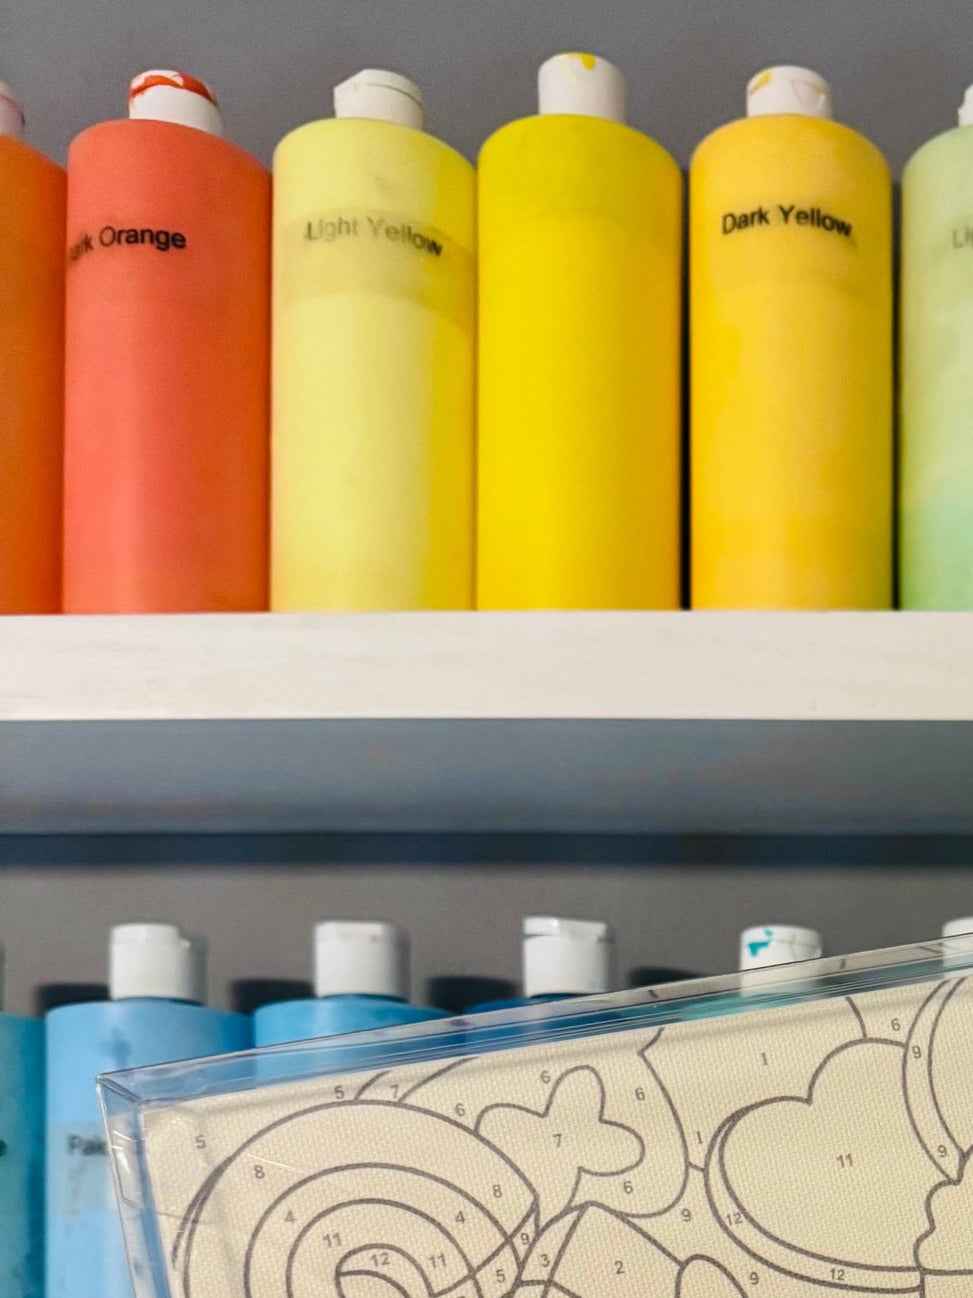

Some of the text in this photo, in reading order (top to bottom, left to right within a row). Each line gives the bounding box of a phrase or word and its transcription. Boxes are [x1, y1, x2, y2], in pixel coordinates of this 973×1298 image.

[721, 205, 852, 238] Dark Yellow
[69, 226, 187, 262] ark Orange
[304, 216, 444, 258] Light Yellow
[891, 1018, 901, 1031] 6
[912, 1046, 922, 1059] 9
[540, 1070, 551, 1084] 6
[334, 1085, 345, 1098] 5
[389, 1082, 399, 1097] 7
[635, 1088, 645, 1101] 6
[455, 1103, 465, 1117] 6
[195, 1134, 206, 1149] 5
[553, 1133, 562, 1147] 7
[938, 1144, 947, 1157] 9
[837, 1153, 853, 1167] 11
[254, 1165, 265, 1179] 8
[492, 1184, 502, 1198] 8
[623, 1181, 633, 1194] 6
[285, 1210, 296, 1223] 4
[455, 1210, 466, 1224] 4
[681, 1208, 692, 1222] 9
[323, 1233, 341, 1247] 11
[371, 1252, 390, 1266] 12
[429, 1253, 446, 1268] 11
[540, 1253, 550, 1267] 3
[615, 1261, 624, 1275] 2
[831, 1268, 845, 1281] 12
[496, 1269, 506, 1283] 5
[750, 1271, 759, 1285] 9
